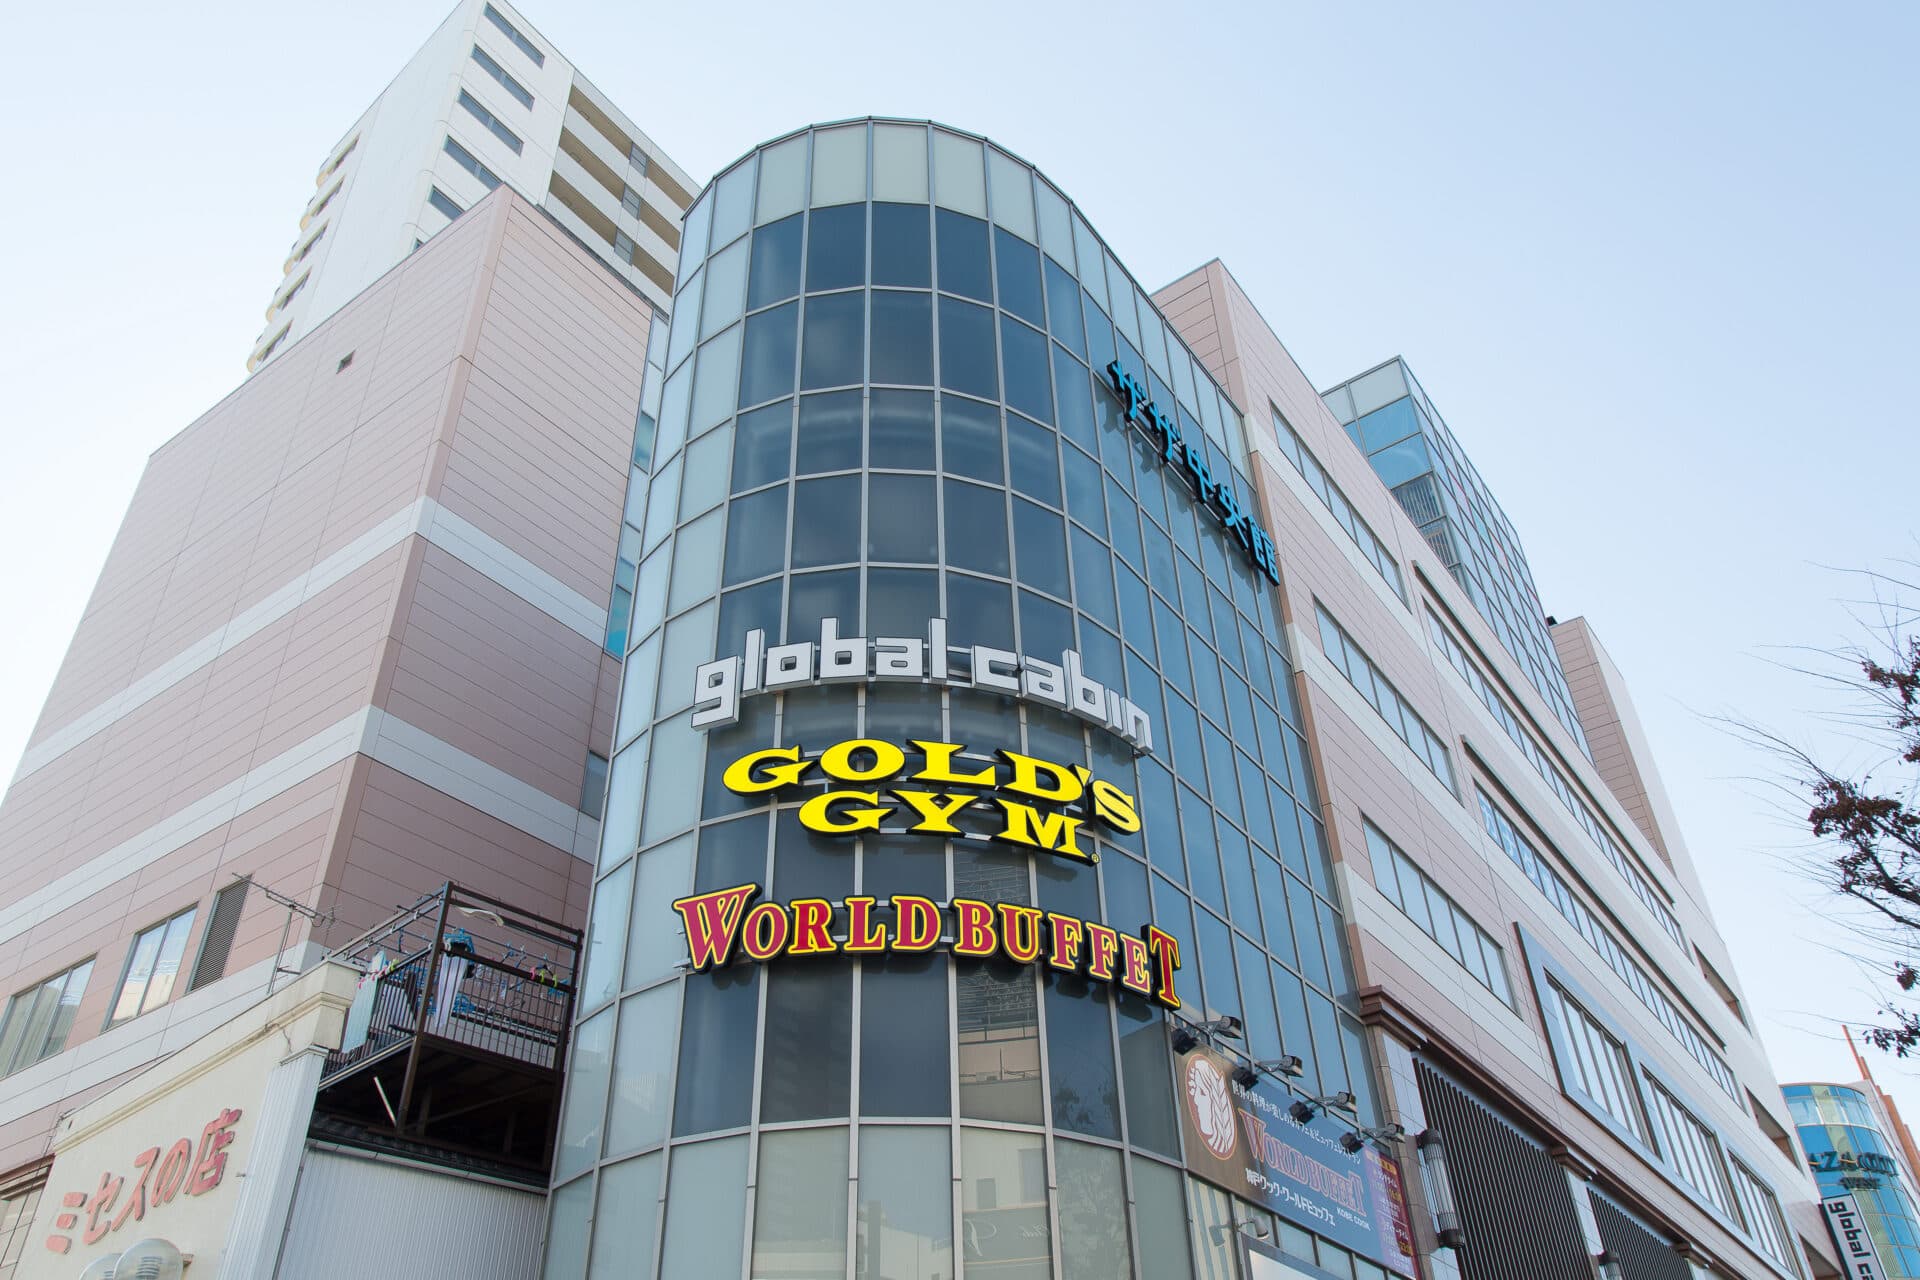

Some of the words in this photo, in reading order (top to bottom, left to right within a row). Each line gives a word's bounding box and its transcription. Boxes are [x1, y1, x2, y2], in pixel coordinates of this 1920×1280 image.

[1107, 360, 1279, 586] ザザ中央館
[691, 617, 948, 730] global
[971, 645, 1154, 756] cabin
[721, 737, 1143, 834] GOLD'S
[798, 790, 1097, 865] GYM
[672, 883, 943, 974] WORLD
[952, 897, 1183, 1010] BUFFET
[46, 1108, 243, 1255] ミセスの店
[1238, 1107, 1310, 1186] WORLD
[1828, 1201, 1871, 1258] global
